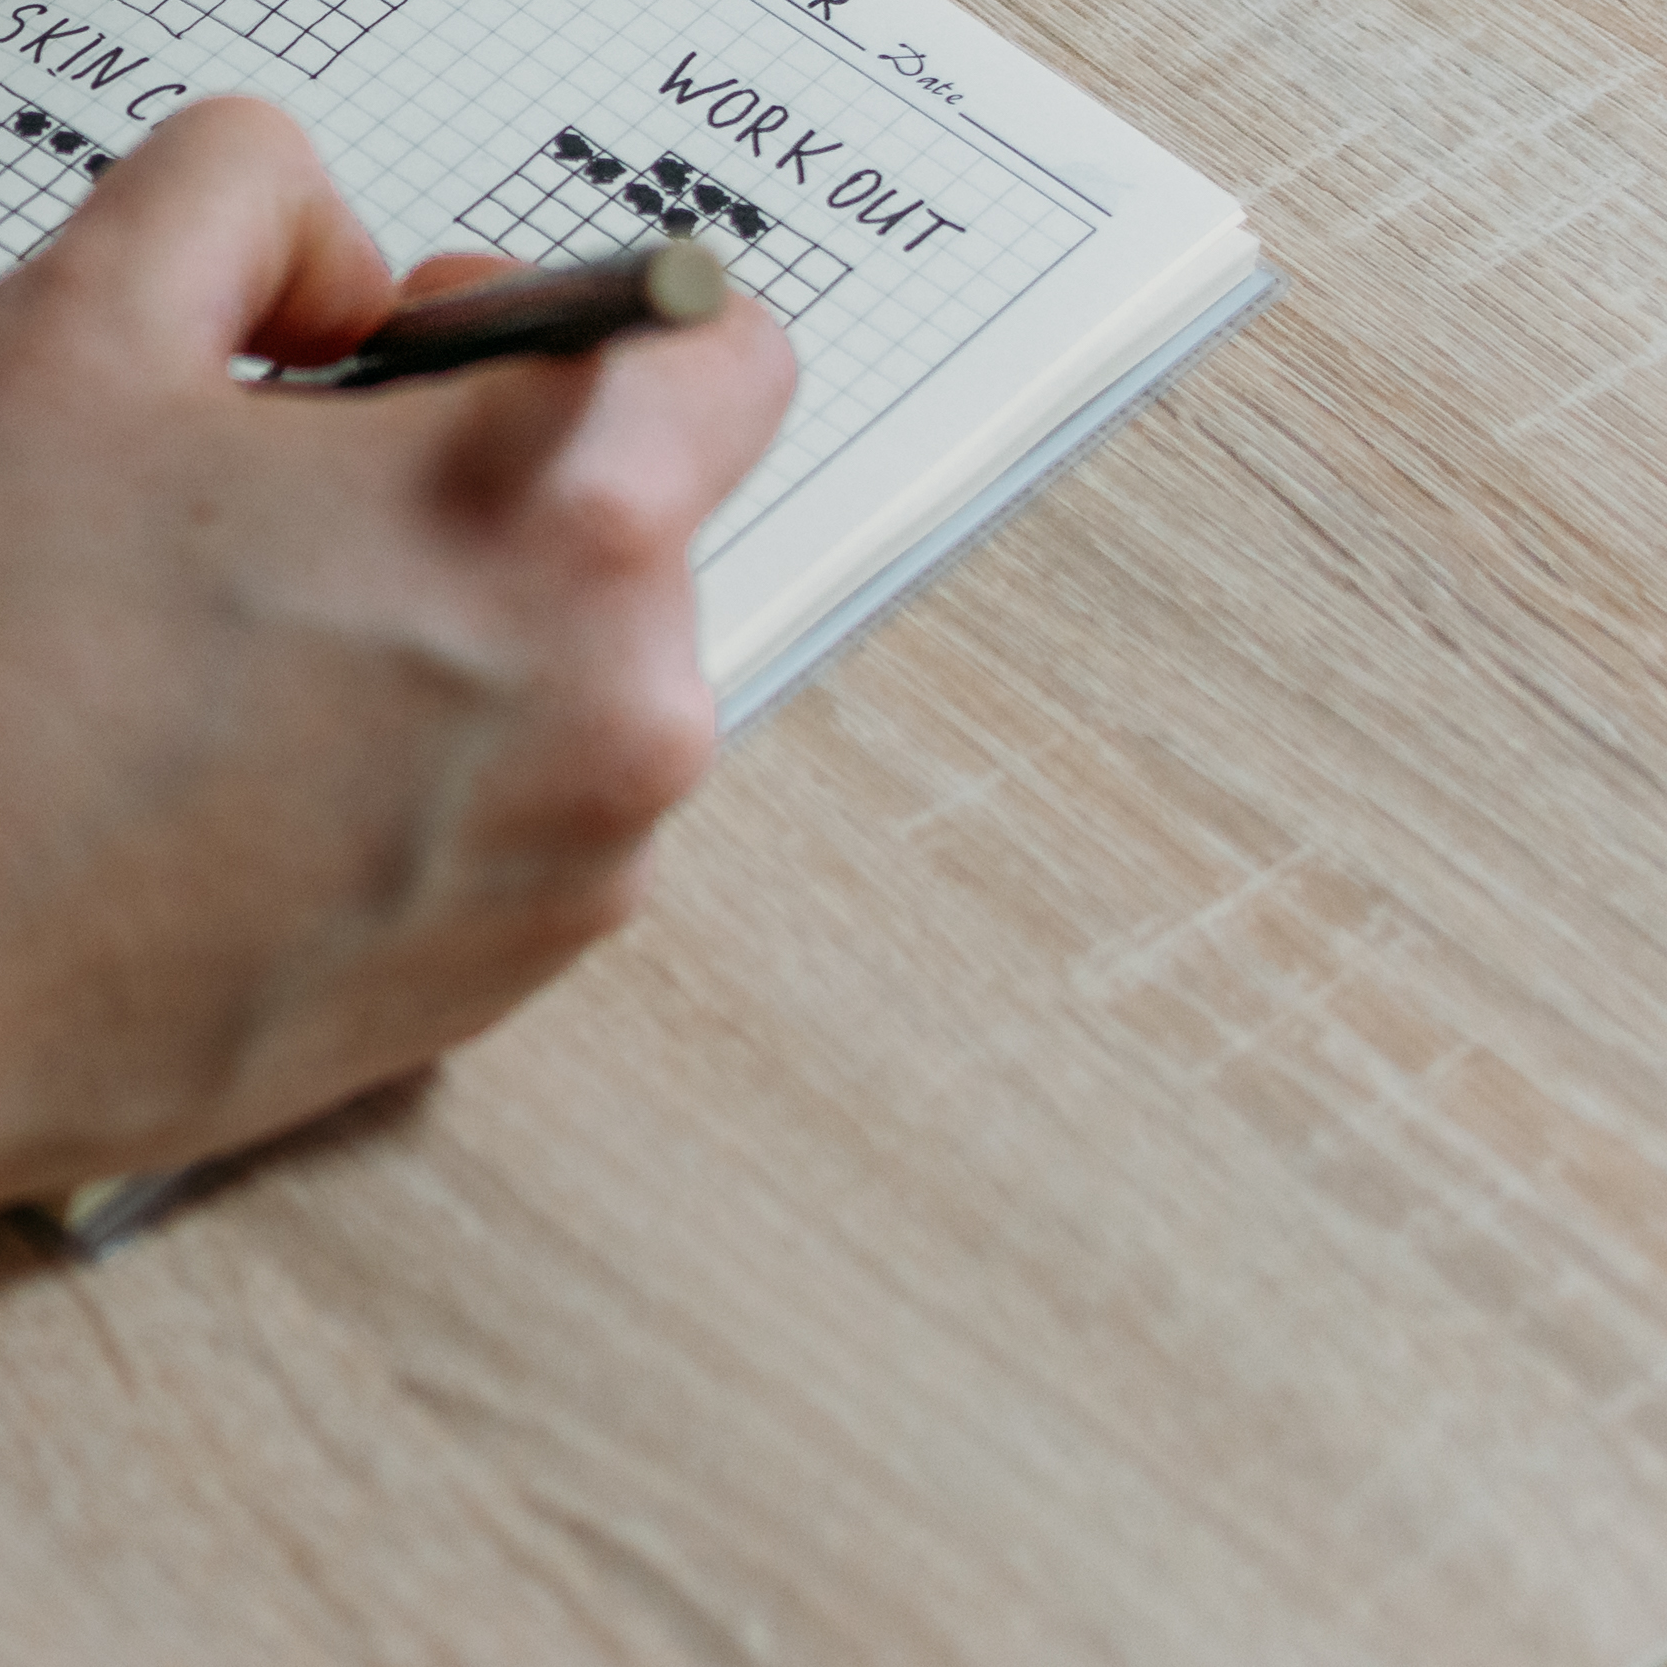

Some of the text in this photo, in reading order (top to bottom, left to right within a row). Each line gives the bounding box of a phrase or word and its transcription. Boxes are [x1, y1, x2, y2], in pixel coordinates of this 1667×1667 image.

[126, 83, 187, 122] C
[878, 43, 964, 105] Date
[658, 51, 966, 252] WORK OUT
